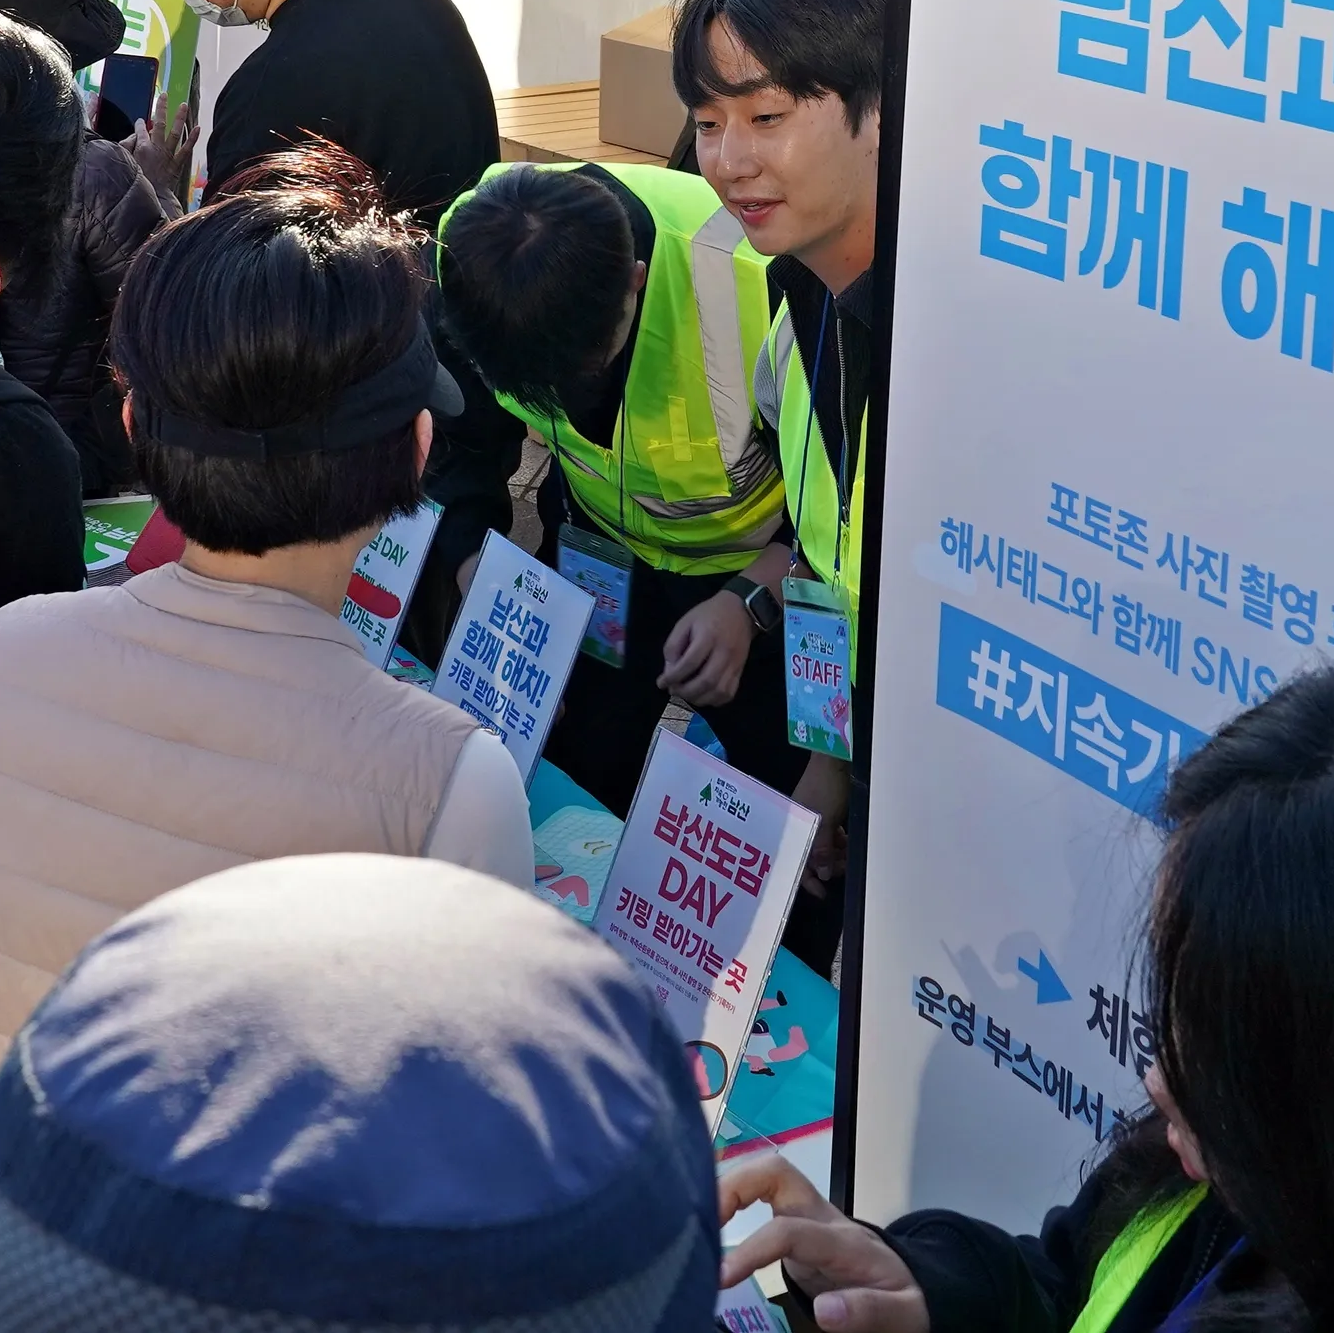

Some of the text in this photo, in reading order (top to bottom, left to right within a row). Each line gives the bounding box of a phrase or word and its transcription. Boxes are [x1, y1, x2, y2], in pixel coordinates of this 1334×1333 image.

[979, 119, 1189, 321] 함께
[380, 536, 410, 568] DAY
[1047, 481, 1149, 571] 포토존
[1156, 532, 1229, 609] 사진
[1239, 564, 1317, 646] 촬영
[372, 621, 387, 647] 곳
[488, 589, 551, 658] 남산과
[940, 516, 1104, 636] 해시태그와
[1112, 593, 1182, 676] 함께
[448, 658, 475, 692] 키링
[473, 676, 521, 729] 받아가는
[519, 713, 536, 740] 곳
[461, 619, 551, 708] 함께 해치!
[791, 654, 843, 687] STAFF
[654, 794, 772, 897] 남산도감
[727, 796, 750, 822] 남산
[658, 856, 733, 929] DAY
[616, 887, 654, 929] 키링
[653, 910, 724, 979] 받아가는
[725, 958, 748, 994] 곳
[916, 976, 1104, 1143] 운영 부스에서
